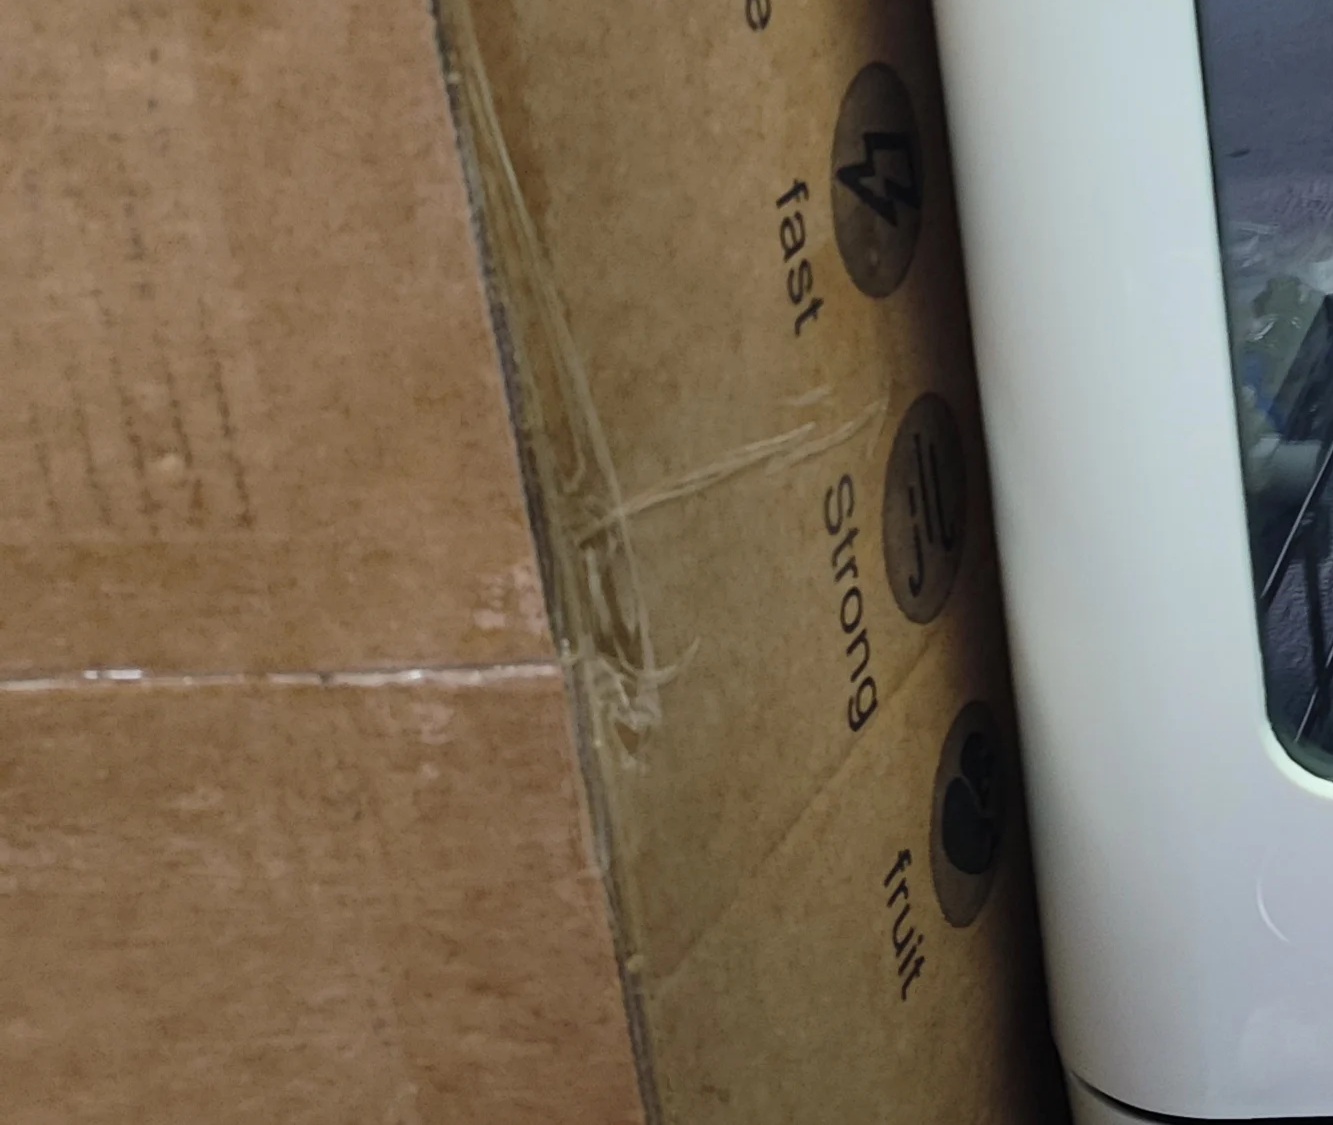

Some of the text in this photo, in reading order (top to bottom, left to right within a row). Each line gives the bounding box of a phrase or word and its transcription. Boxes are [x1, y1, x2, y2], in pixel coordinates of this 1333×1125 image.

[775, 177, 826, 338] fast
[823, 473, 879, 733] Strong
[883, 848, 927, 1002] fruit
